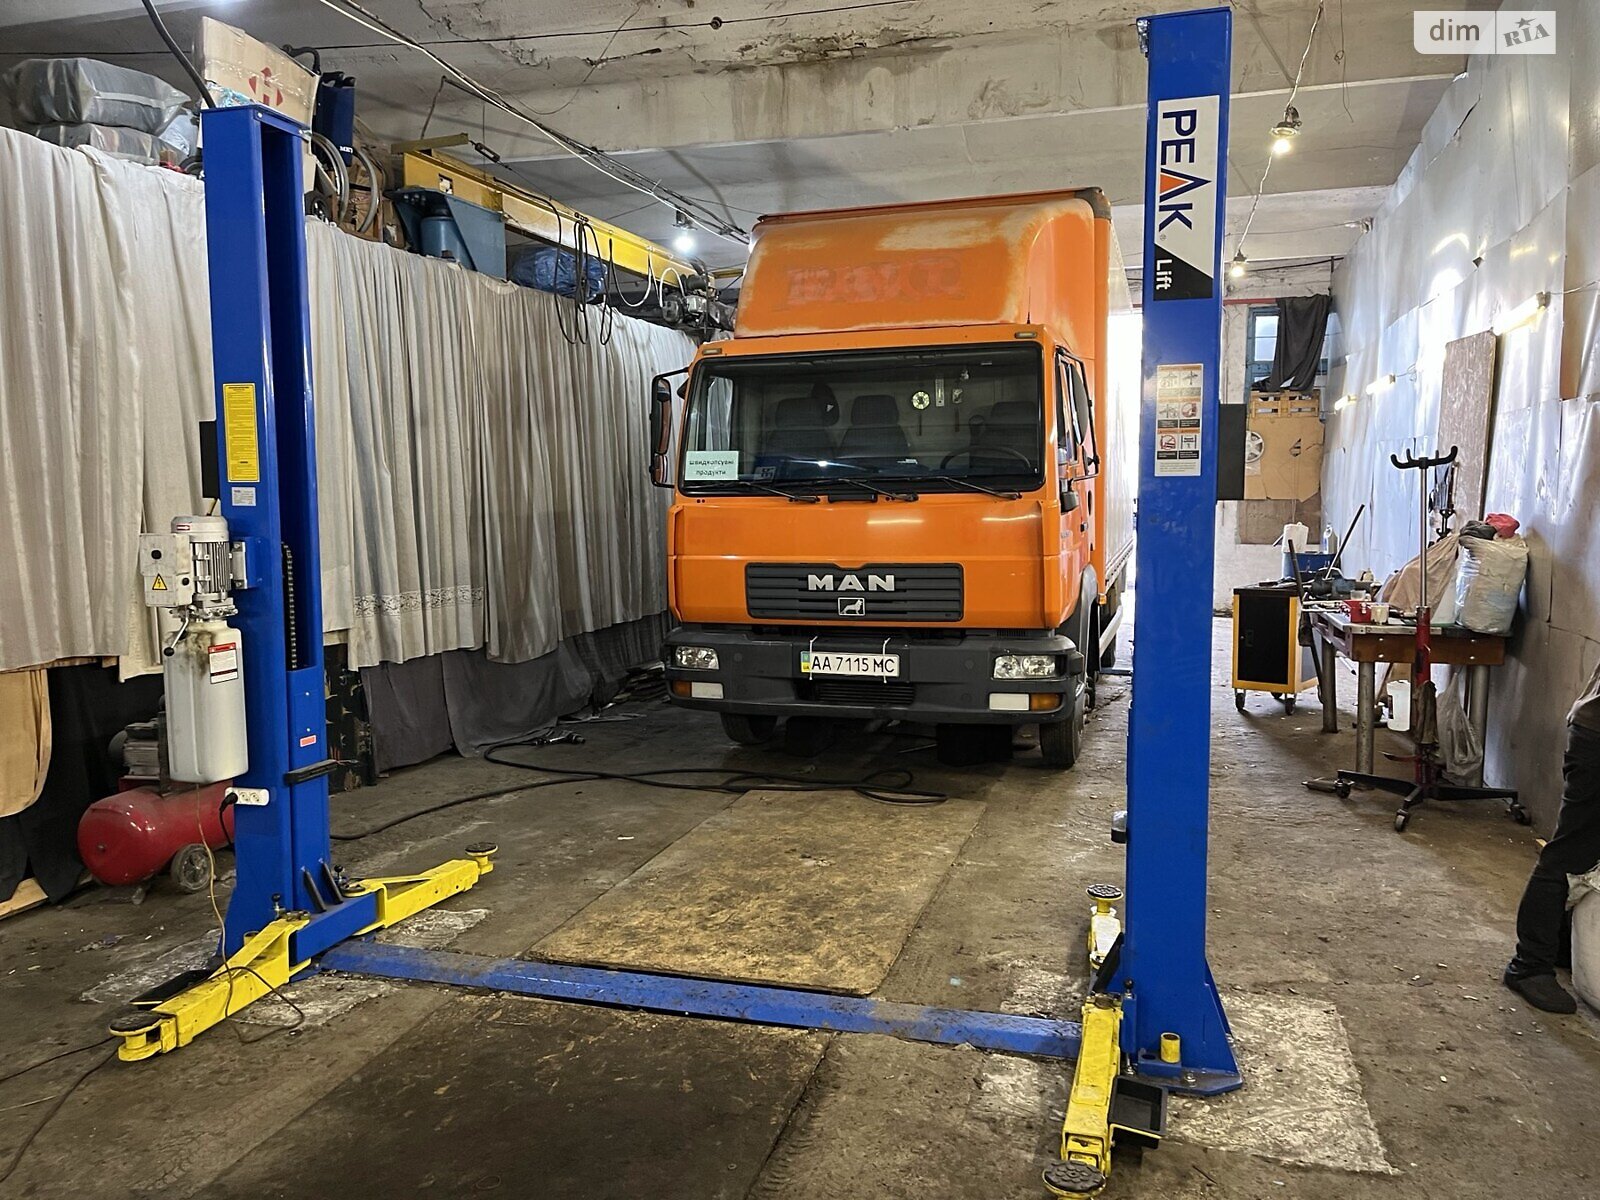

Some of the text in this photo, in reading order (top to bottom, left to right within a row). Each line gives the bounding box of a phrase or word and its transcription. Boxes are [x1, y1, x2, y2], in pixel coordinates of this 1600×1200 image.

[1158, 109, 1212, 233] PEAK
[1156, 258, 1173, 291] Lift
[807, 574, 895, 591] MAN
[811, 656, 895, 673] AA 7115 MC
